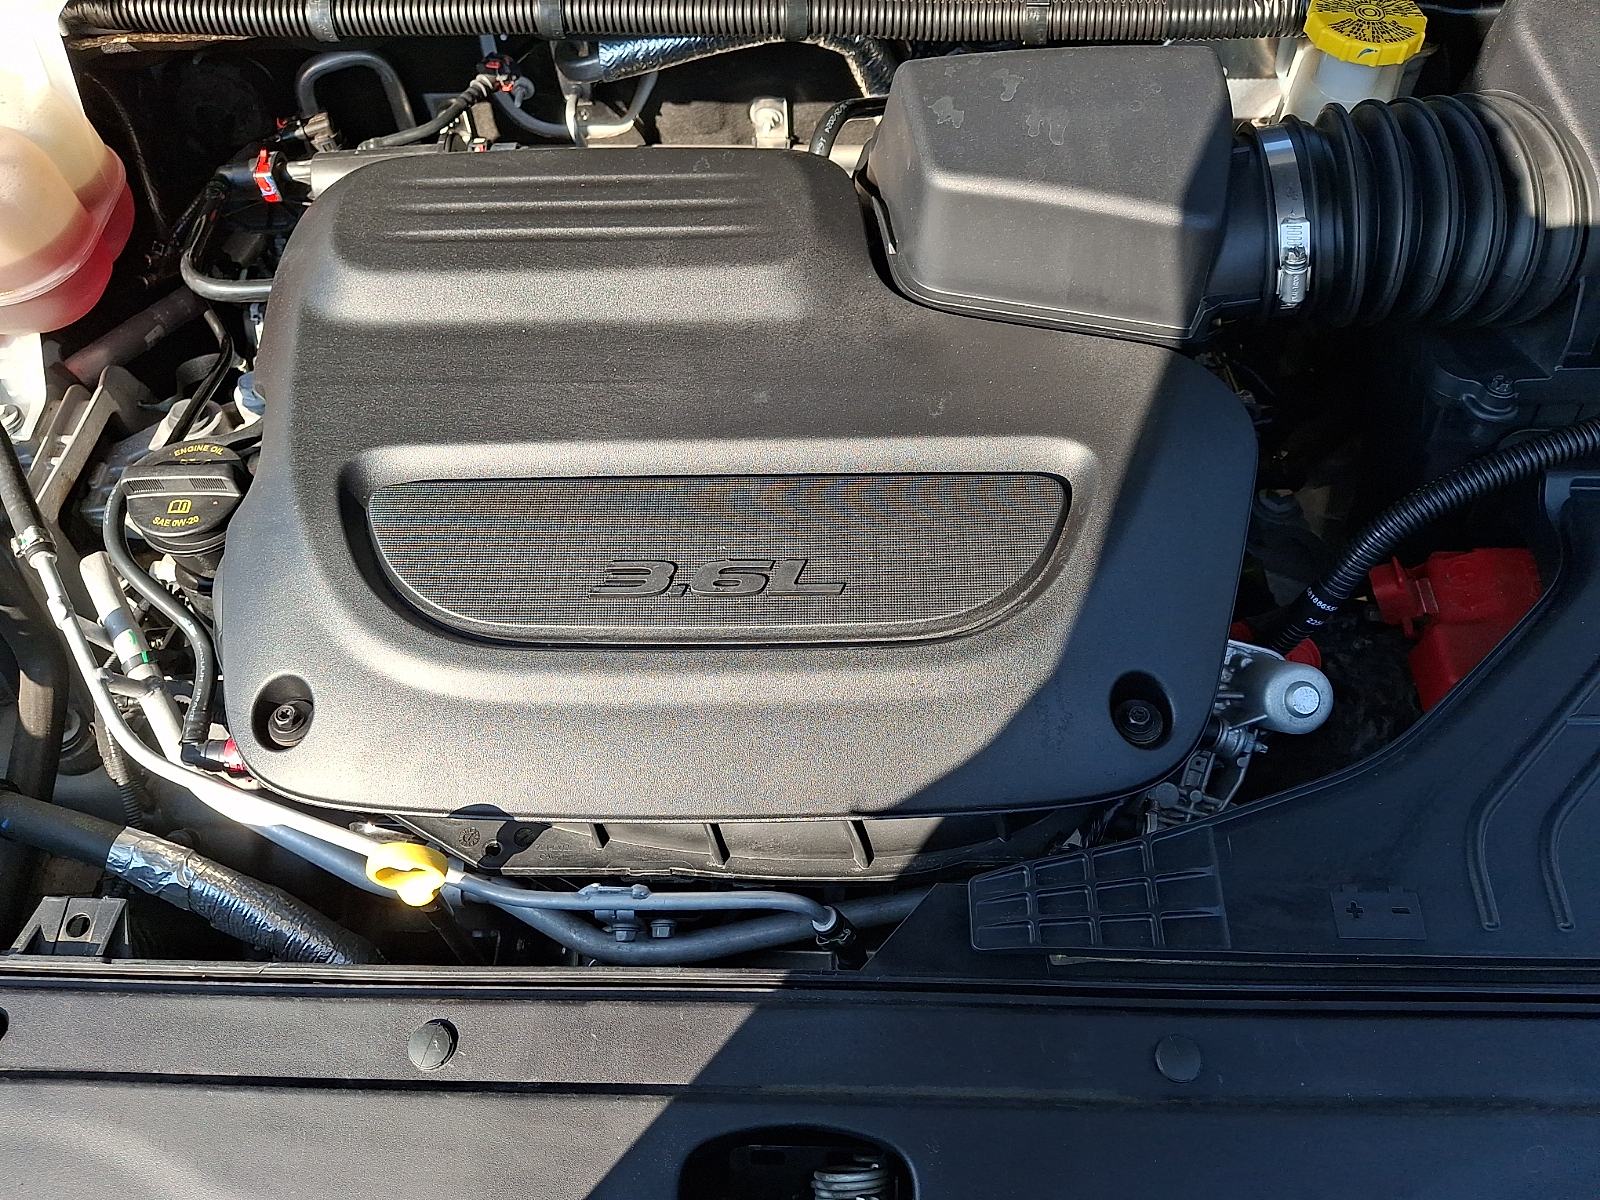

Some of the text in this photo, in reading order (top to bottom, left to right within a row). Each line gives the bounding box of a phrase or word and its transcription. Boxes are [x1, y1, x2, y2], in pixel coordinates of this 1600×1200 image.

[174, 444, 224, 456] ENGINE OIL
[152, 515, 200, 527] SAE 0W-20
[588, 559, 847, 598] 3.6L
